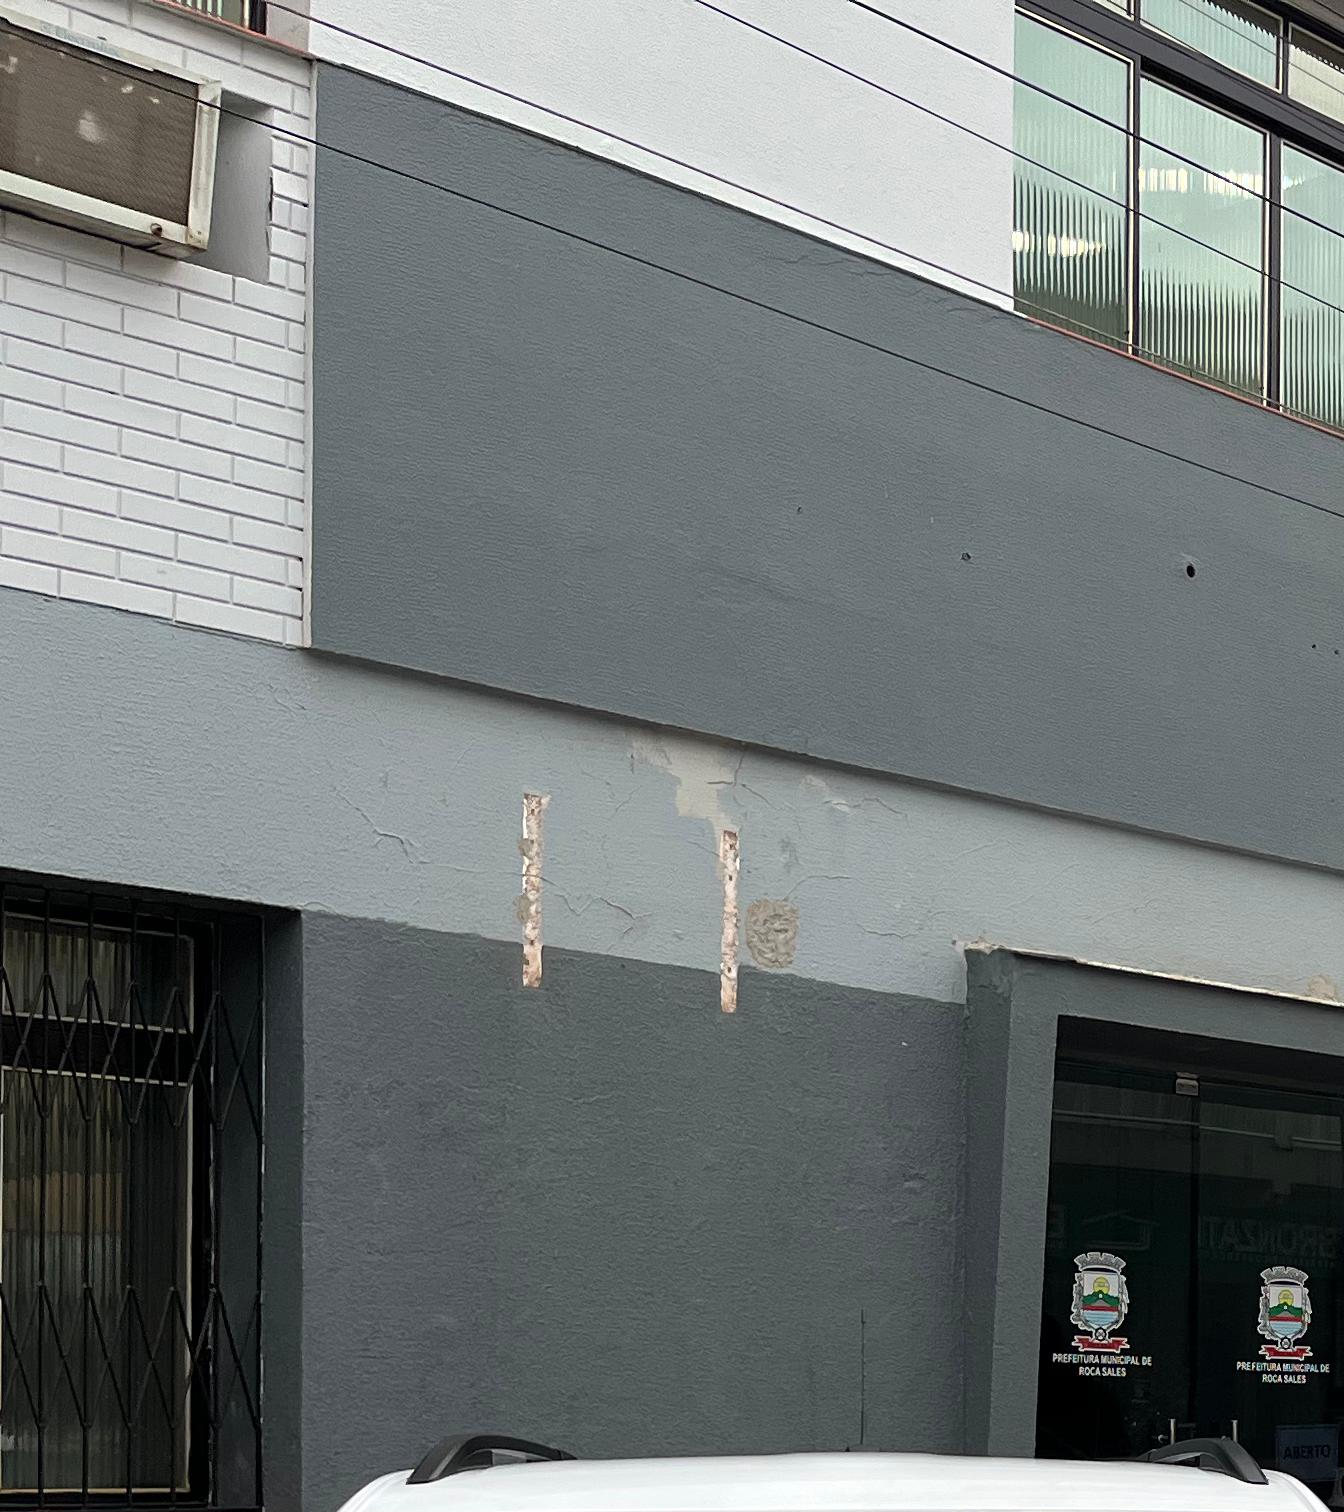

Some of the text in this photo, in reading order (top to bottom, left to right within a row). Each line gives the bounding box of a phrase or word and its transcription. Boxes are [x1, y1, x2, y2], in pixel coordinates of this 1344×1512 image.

[1052, 1353, 1152, 1366] PREFEITURA MUNICIPAL DE
[1079, 1366, 1127, 1377] ROCA SALES
[1236, 1361, 1330, 1373] PREFEITURA MUNICIPAL DE
[1262, 1374, 1307, 1384] ROCA SALES
[1283, 1444, 1331, 1460] ABERTO
